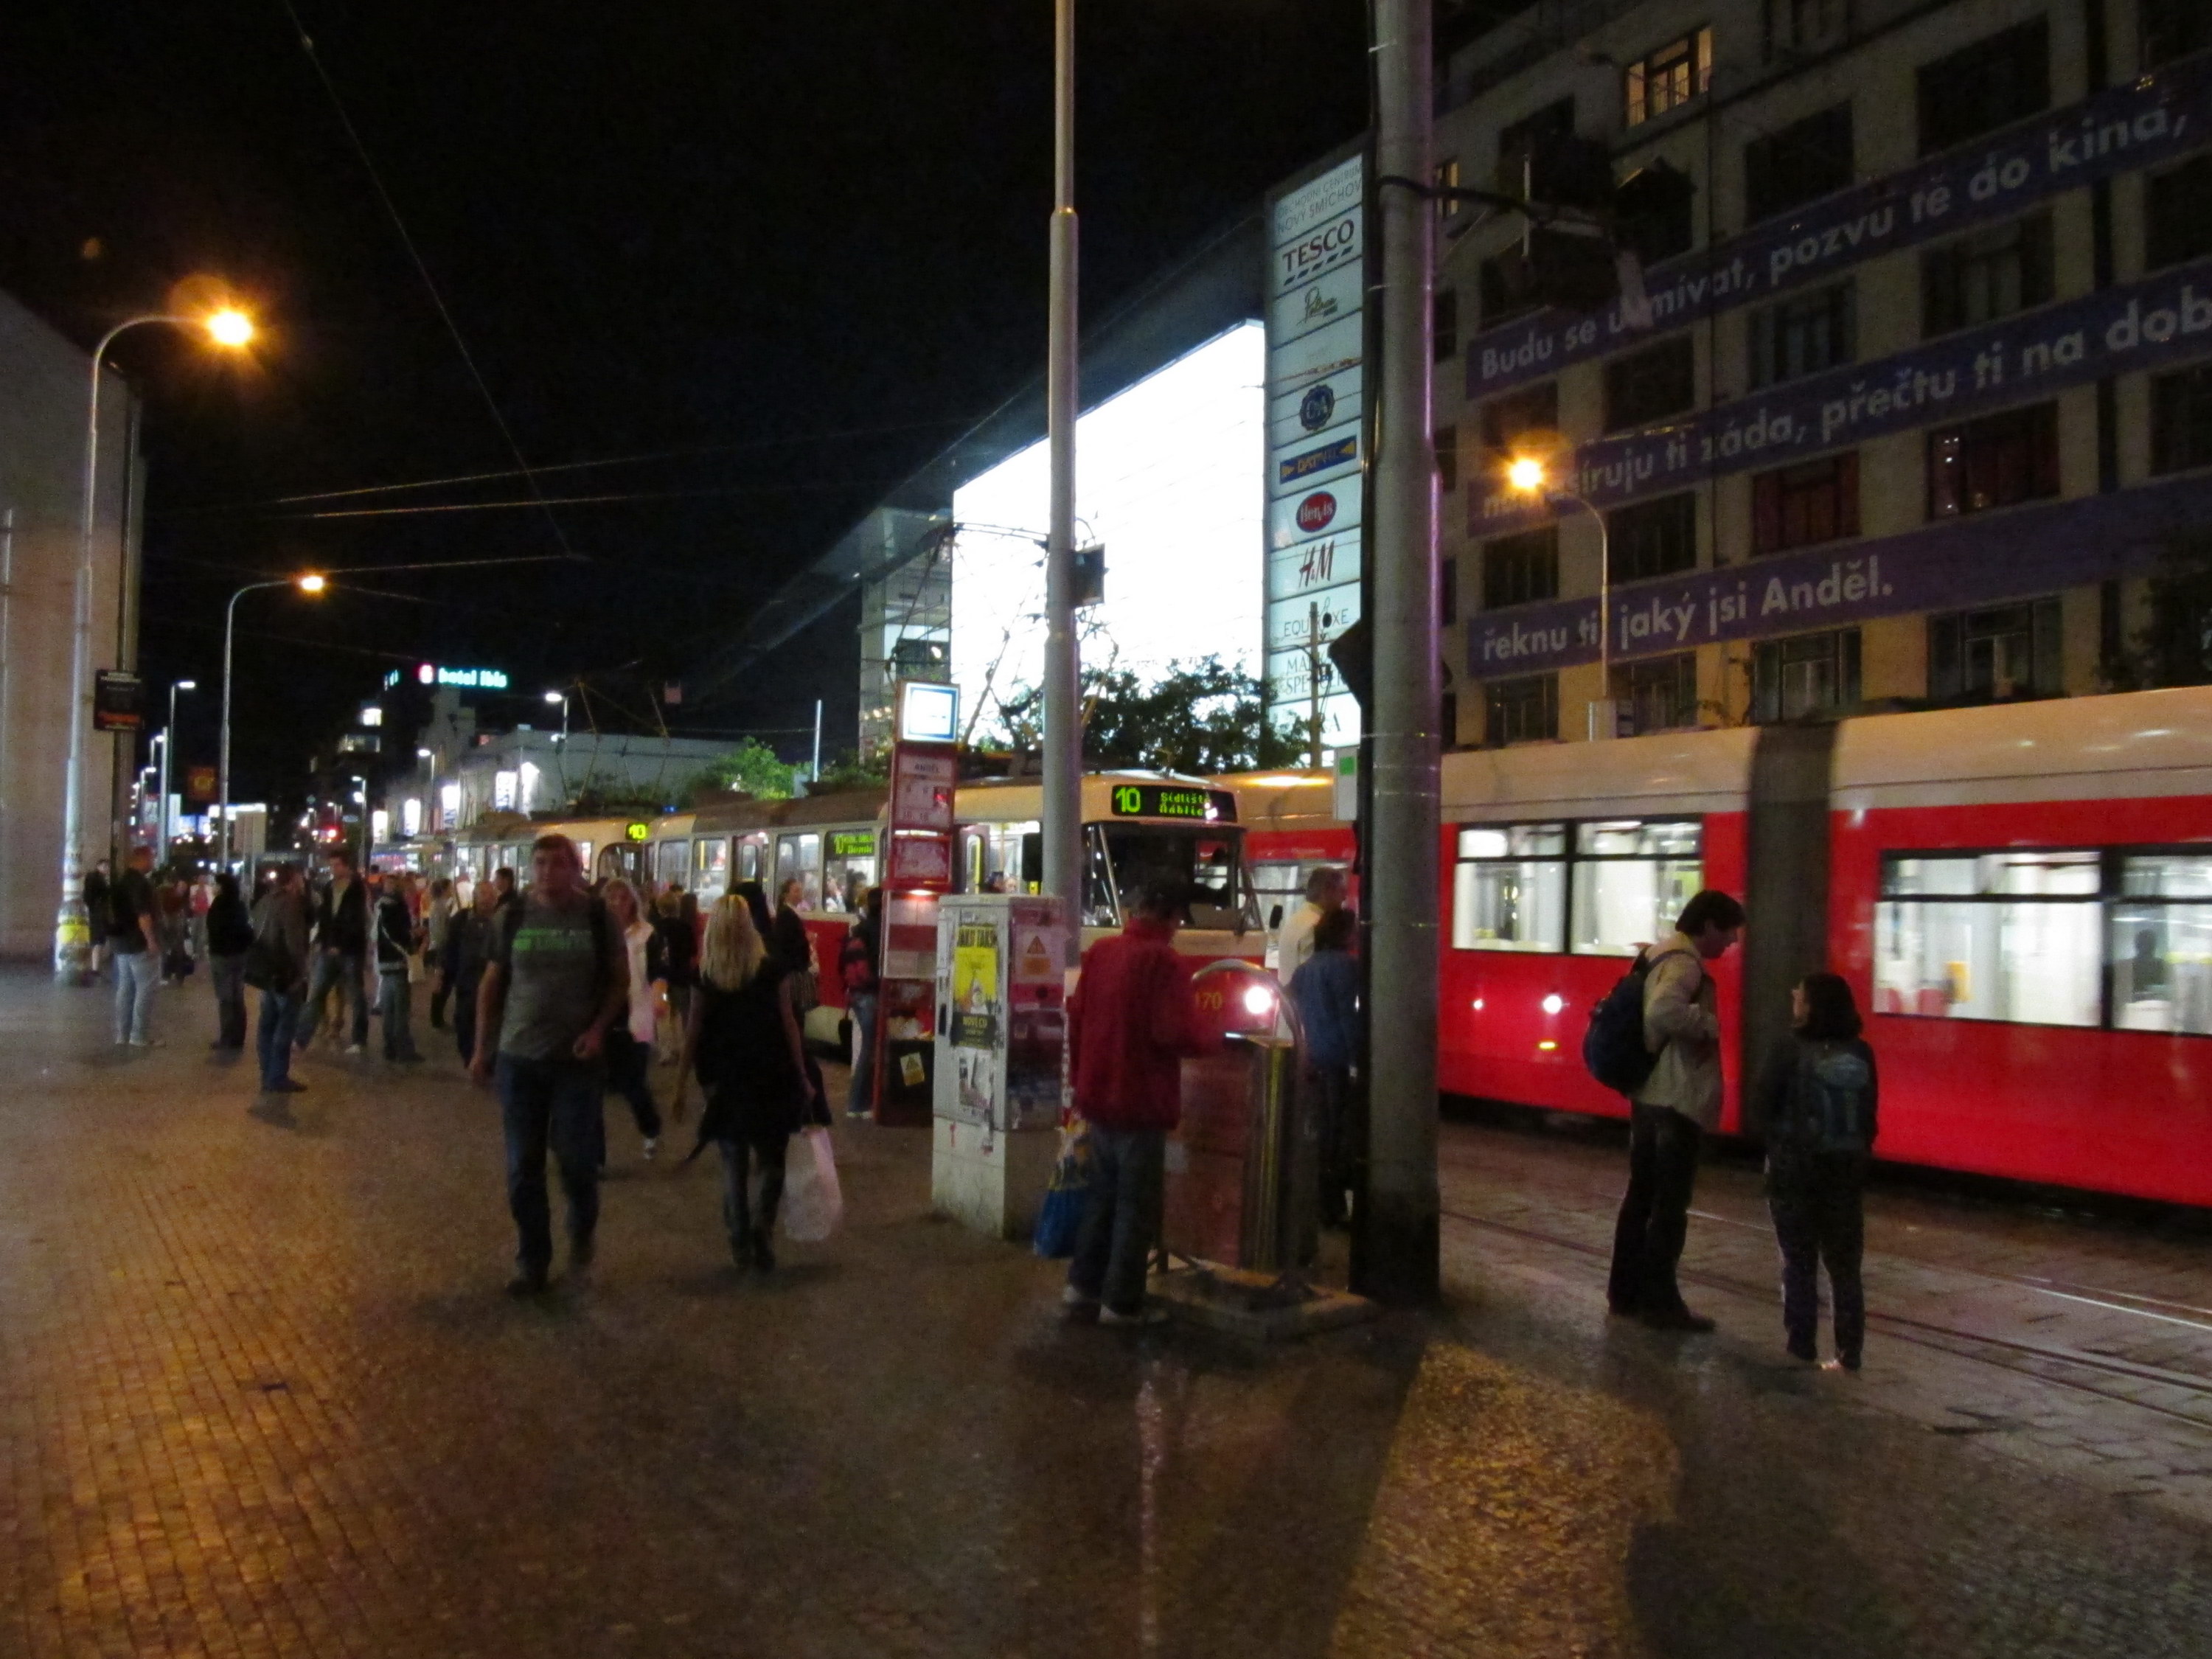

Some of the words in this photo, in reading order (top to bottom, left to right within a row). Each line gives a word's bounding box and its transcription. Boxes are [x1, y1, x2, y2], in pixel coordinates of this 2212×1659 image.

[1281, 219, 1354, 272] TESCO
[1481, 331, 1554, 379] Budu
[1565, 319, 1597, 351] se
[1608, 257, 1756, 333] umívat,
[1770, 206, 1893, 286] pozvu
[1910, 173, 1951, 223] tě
[1969, 150, 2031, 201] do
[2048, 107, 2188, 173] kina,
[1665, 433, 1688, 472] ti
[1700, 408, 1805, 462] záda,
[1821, 366, 1956, 442] přečtu
[1973, 341, 2003, 389] ti
[2021, 331, 2085, 376] na
[1298, 540, 1335, 588] H&M
[1284, 608, 1349, 638] EQUXE
[1482, 621, 1568, 661] řeknu
[1621, 591, 1697, 650] jaký
[1708, 581, 1747, 636] jsi
[1760, 554, 1893, 616] Anděl.
[438, 667, 477, 686] hotel
[479, 669, 507, 688] ibis
[1116, 787, 1141, 813] 10
[629, 824, 647, 840] 10
